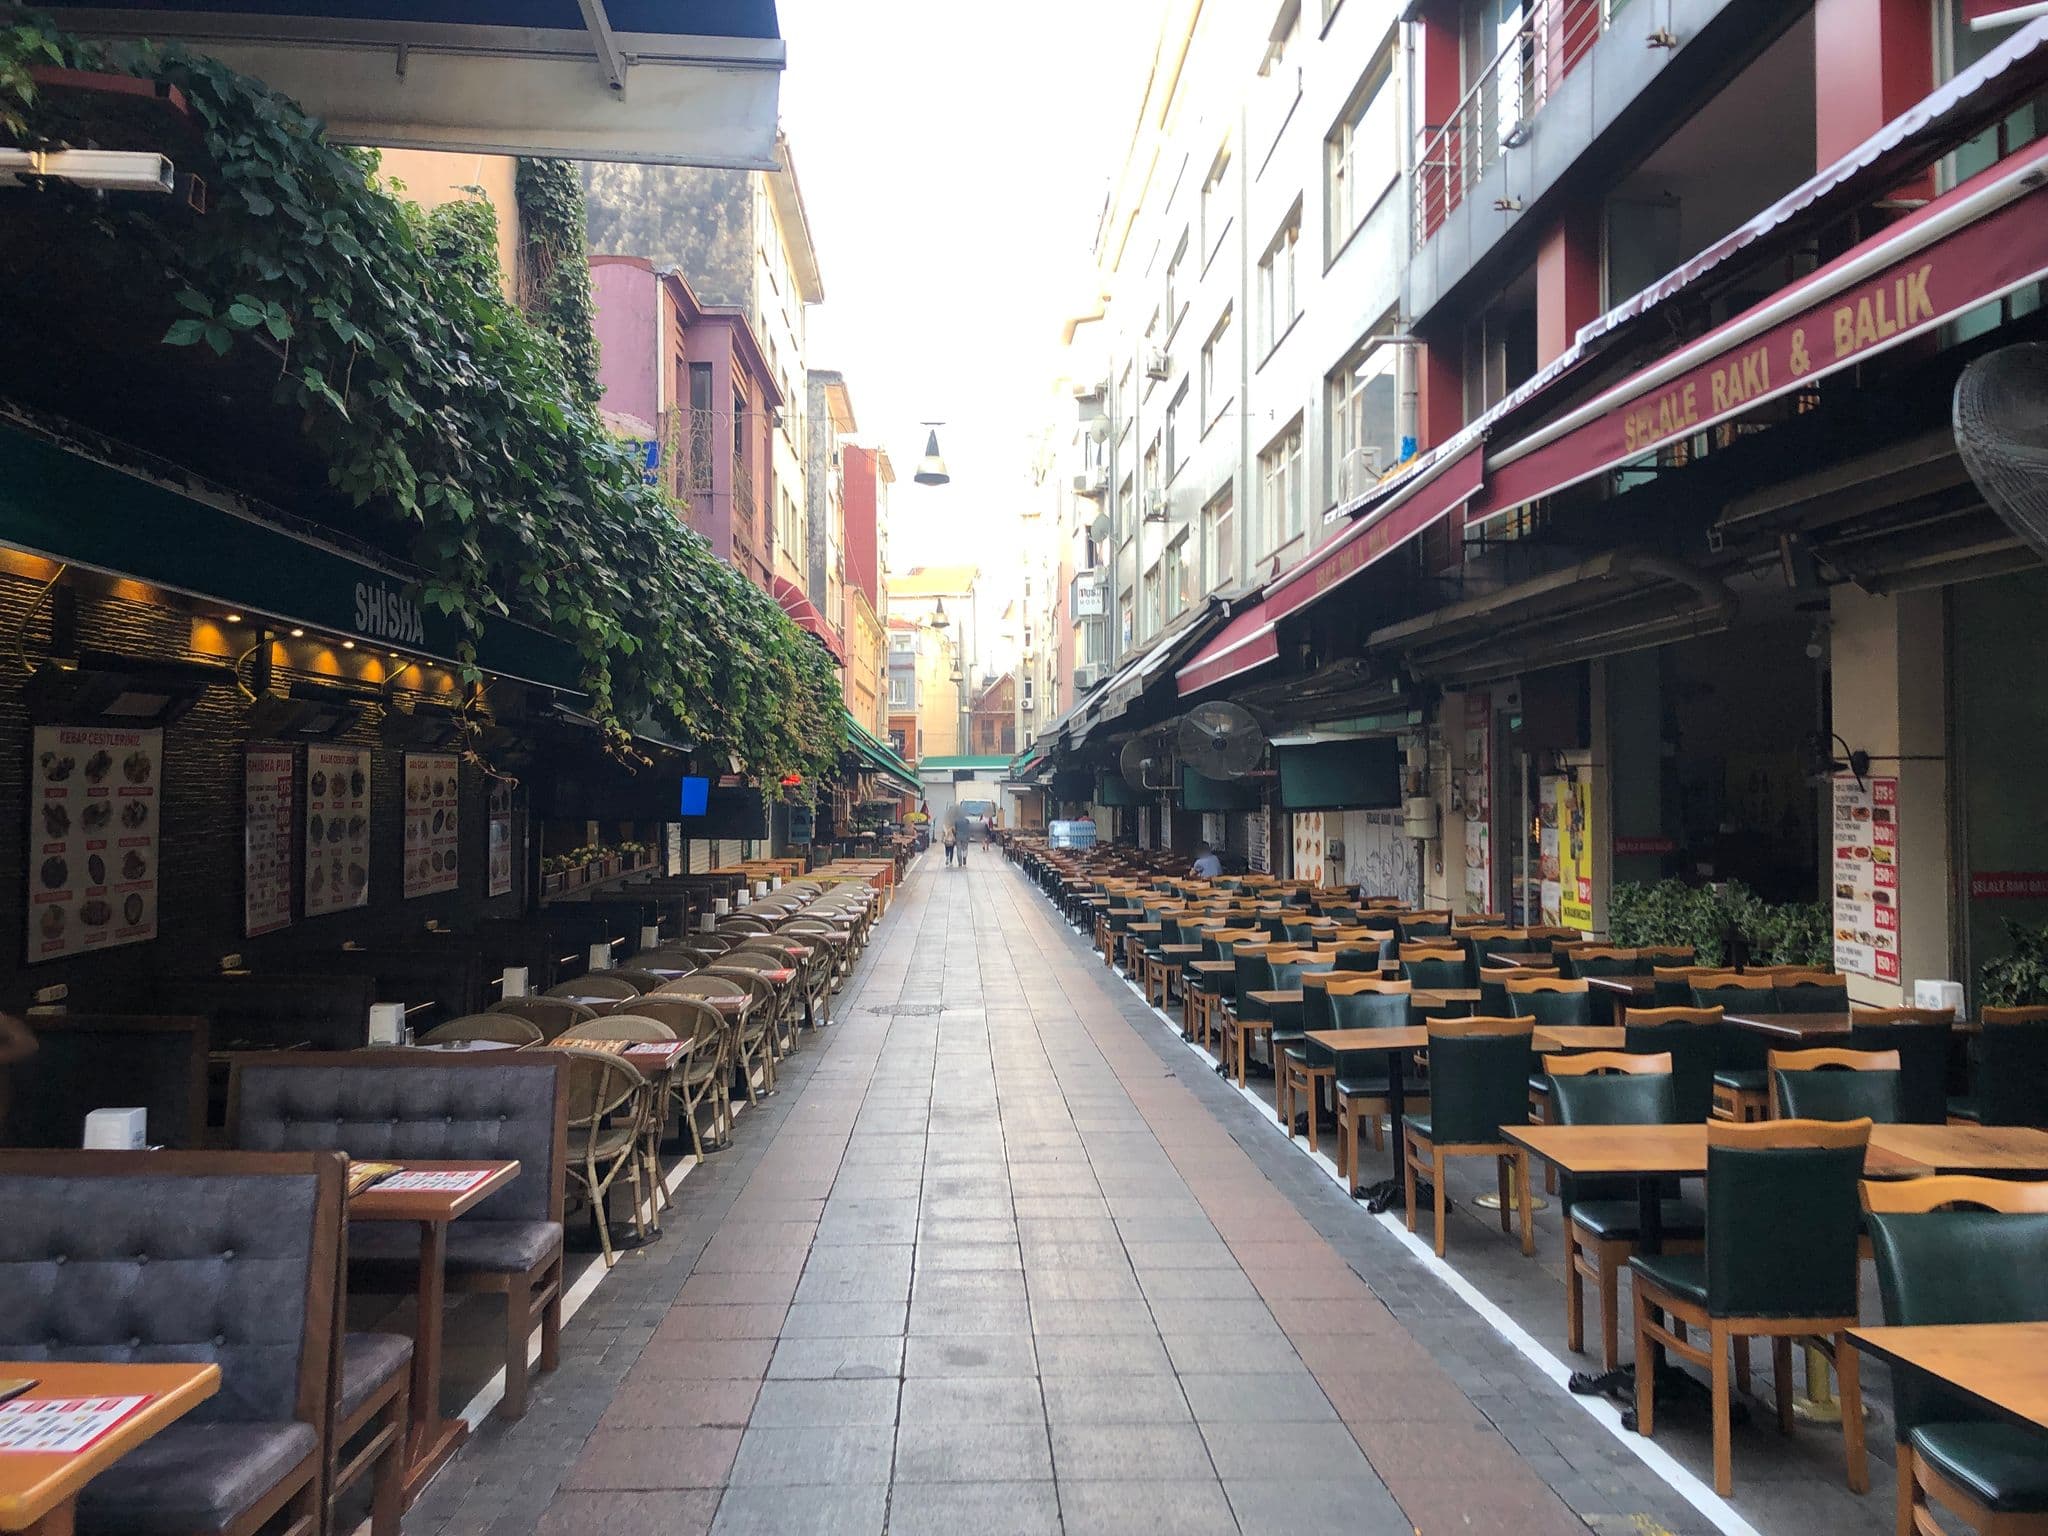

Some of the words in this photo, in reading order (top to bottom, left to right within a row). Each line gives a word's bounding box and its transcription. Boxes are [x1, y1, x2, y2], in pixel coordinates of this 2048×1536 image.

[1711, 347, 1770, 413] RAKI
[1789, 328, 1812, 376] &
[1833, 263, 1935, 359] BALIK
